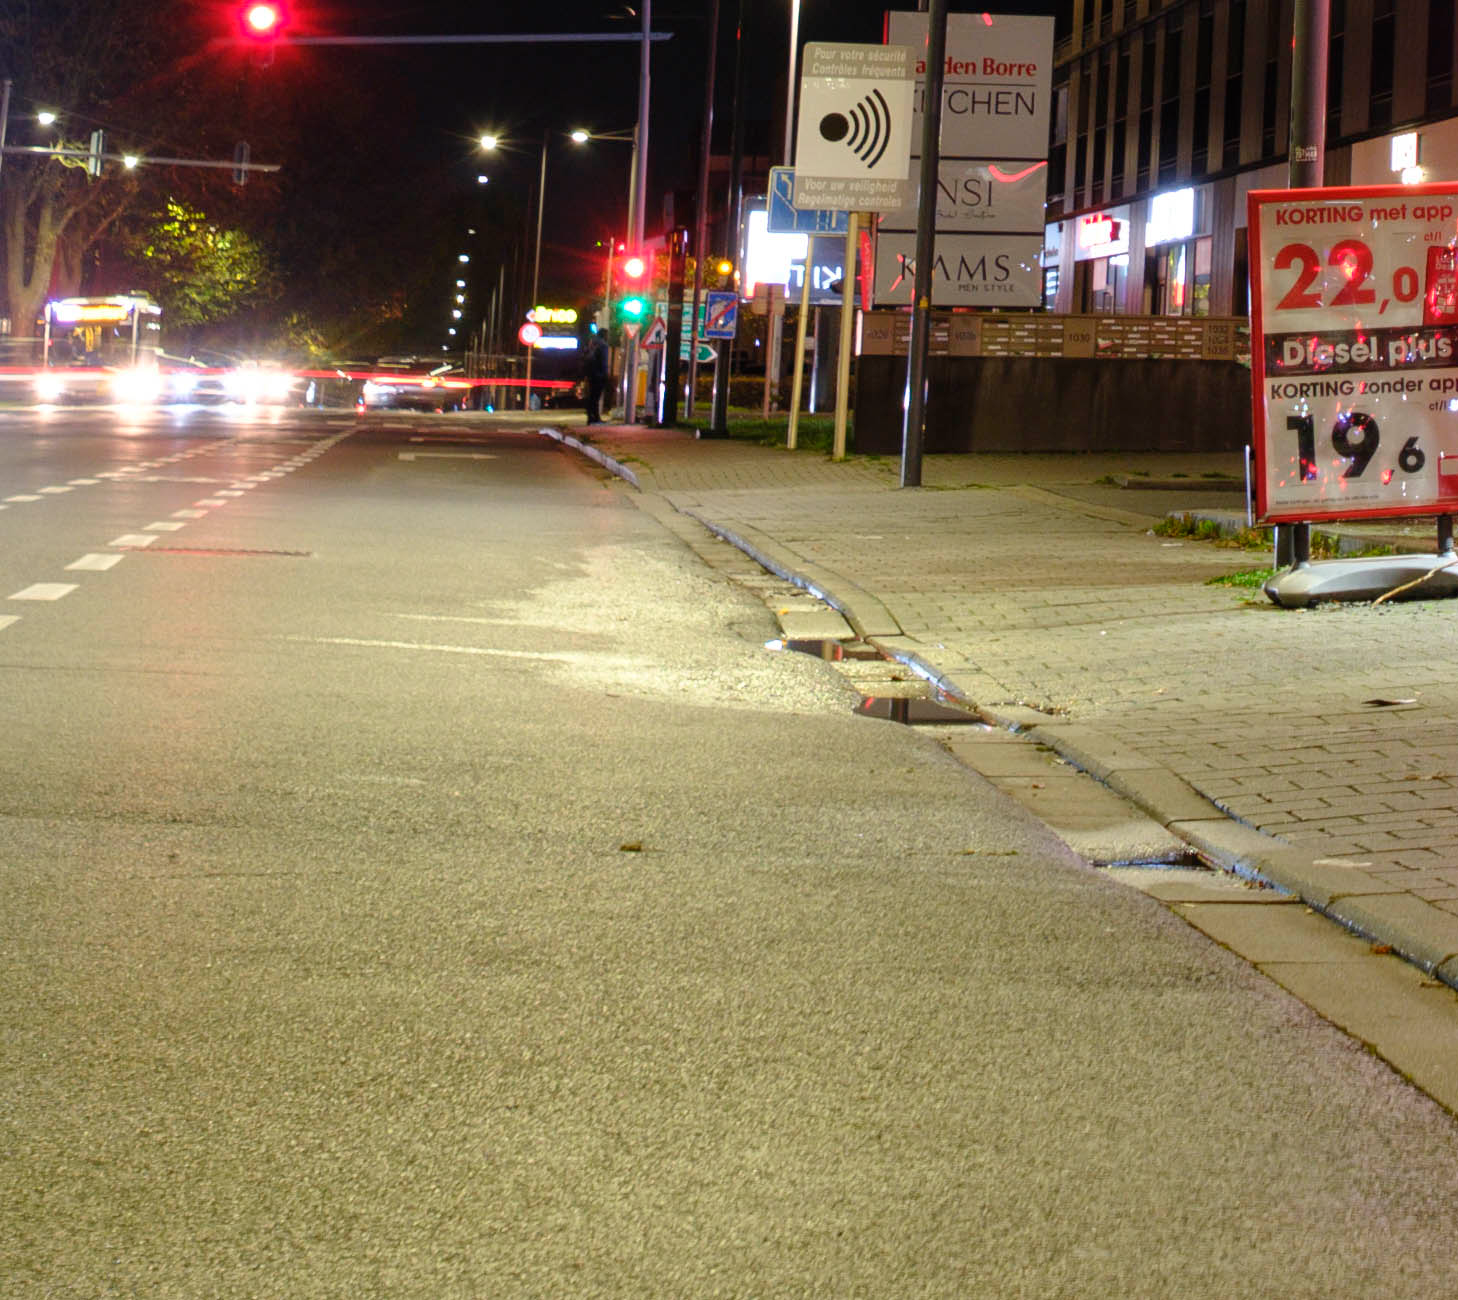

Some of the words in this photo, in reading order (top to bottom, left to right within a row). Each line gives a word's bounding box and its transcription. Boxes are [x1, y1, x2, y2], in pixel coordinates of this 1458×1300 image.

[982, 58, 1037, 77] Borre
[936, 179, 993, 207] NSI
[1276, 206, 1364, 225] KORTING
[1370, 206, 1407, 221] met
[1413, 204, 1453, 221] app
[958, 283, 978, 293] MEN
[984, 284, 1014, 293] STYLE
[1274, 239, 1420, 315] 22,0
[1283, 336, 1378, 366] Diesel
[1389, 332, 1453, 368] plus
[1271, 380, 1354, 400] KORTING
[1358, 378, 1424, 395] zonder
